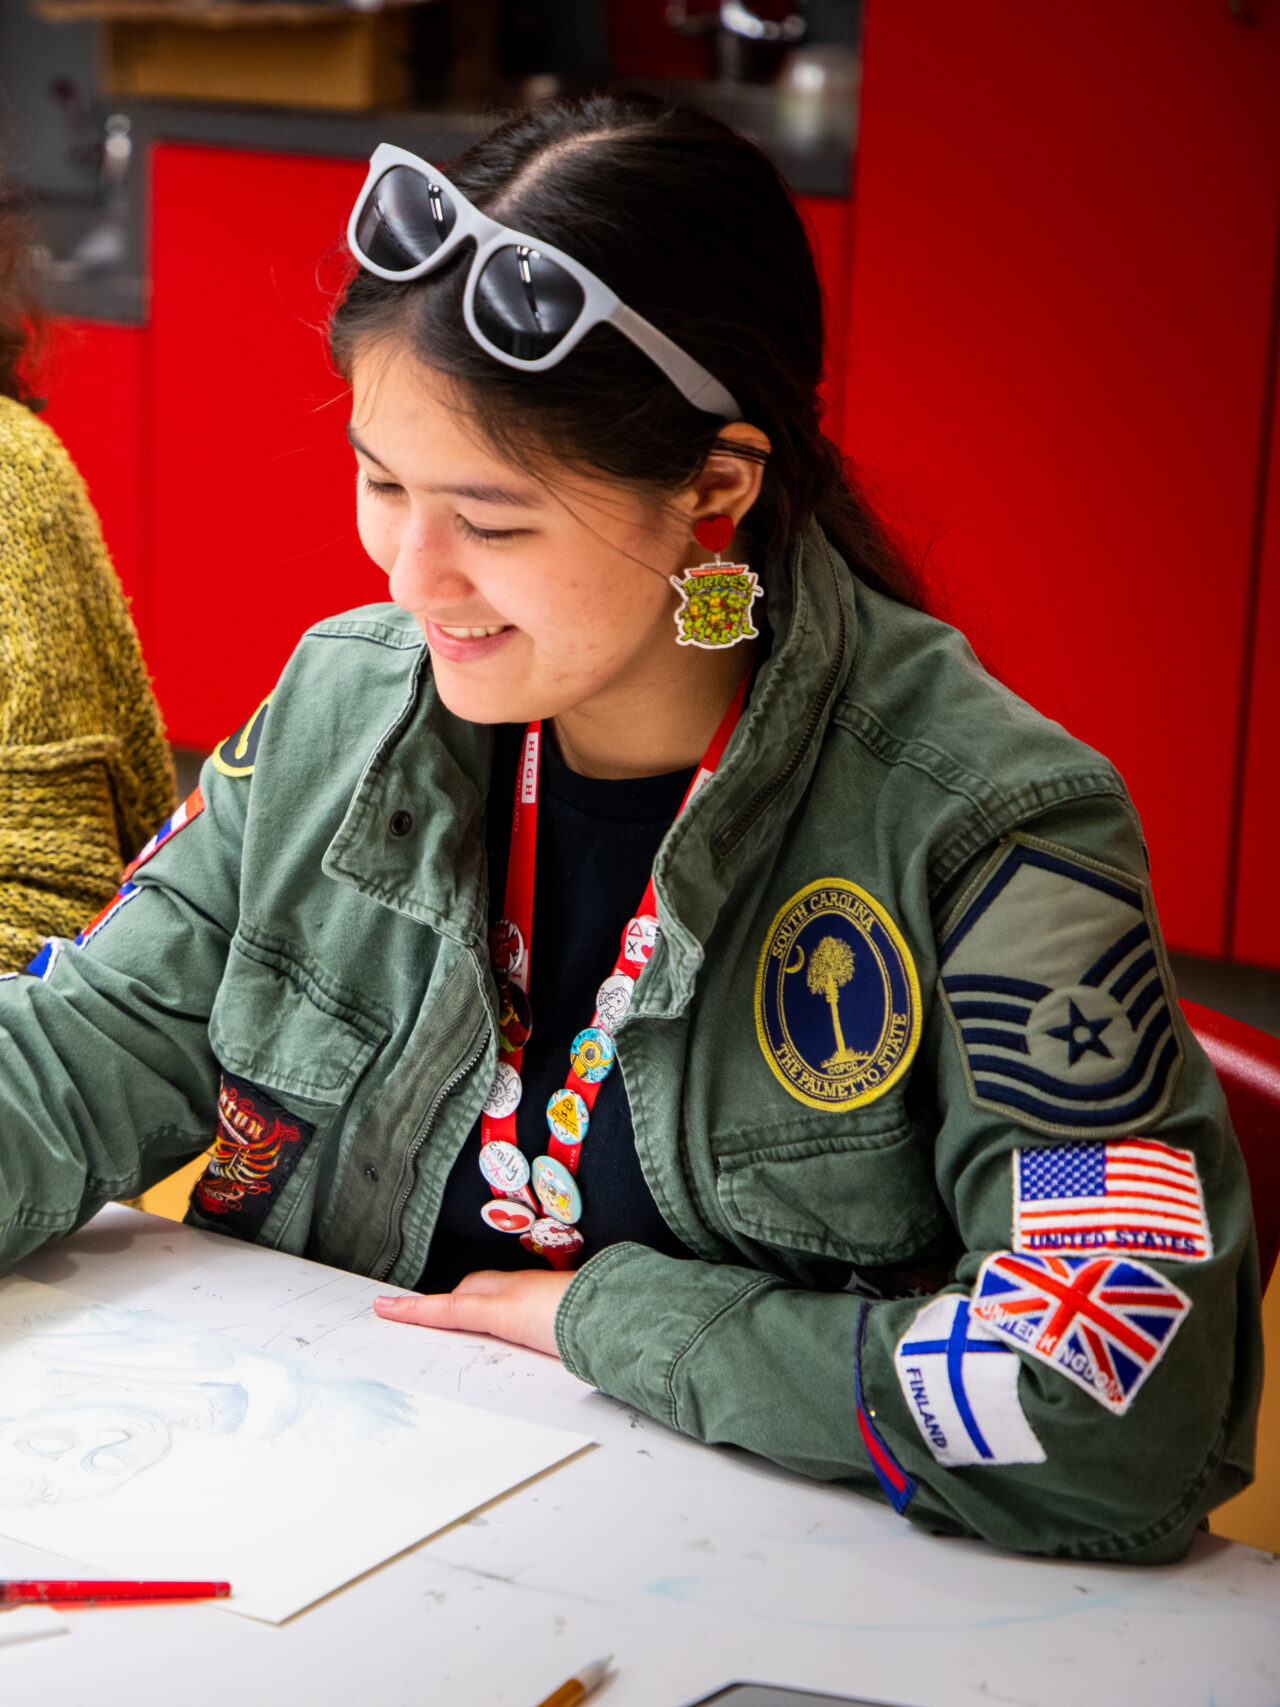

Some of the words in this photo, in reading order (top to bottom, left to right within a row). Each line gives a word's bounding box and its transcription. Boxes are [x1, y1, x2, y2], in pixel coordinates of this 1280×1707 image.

[683, 575, 750, 596] TURTLES
[525, 740, 535, 796] HIGH
[772, 908, 809, 960] SOUTH
[809, 893, 876, 934] CAROLINA
[777, 1042, 800, 1079] THE
[798, 1068, 881, 1098] PALMETTO
[882, 1012, 907, 1072] STATE
[489, 1140, 520, 1182] Emily
[1030, 1232, 1107, 1251] UNITED
[1115, 1230, 1197, 1255] STATES
[980, 1300, 1036, 1345] UNITED
[1038, 1333, 1125, 1404] KNGDOM
[906, 1366, 948, 1450] FINLAND
